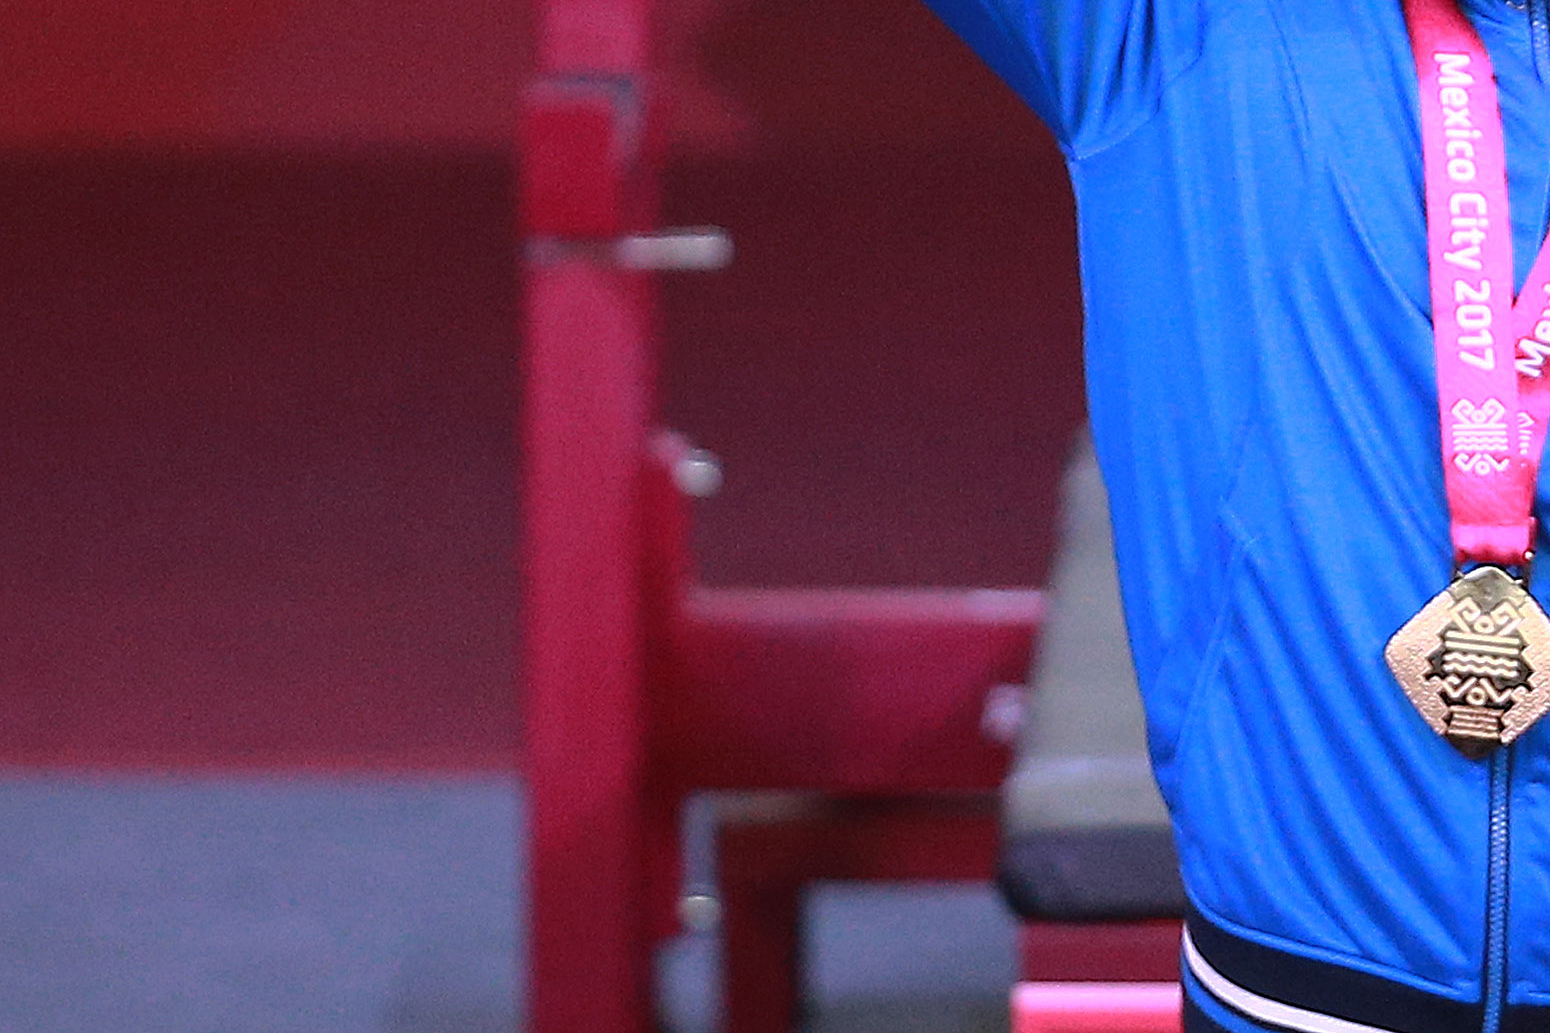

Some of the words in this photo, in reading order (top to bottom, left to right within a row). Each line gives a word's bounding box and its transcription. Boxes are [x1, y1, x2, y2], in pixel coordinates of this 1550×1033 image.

[1433, 51, 1482, 183] Mexico
[1443, 191, 1488, 271] City
[1453, 279, 1497, 370] 2017
